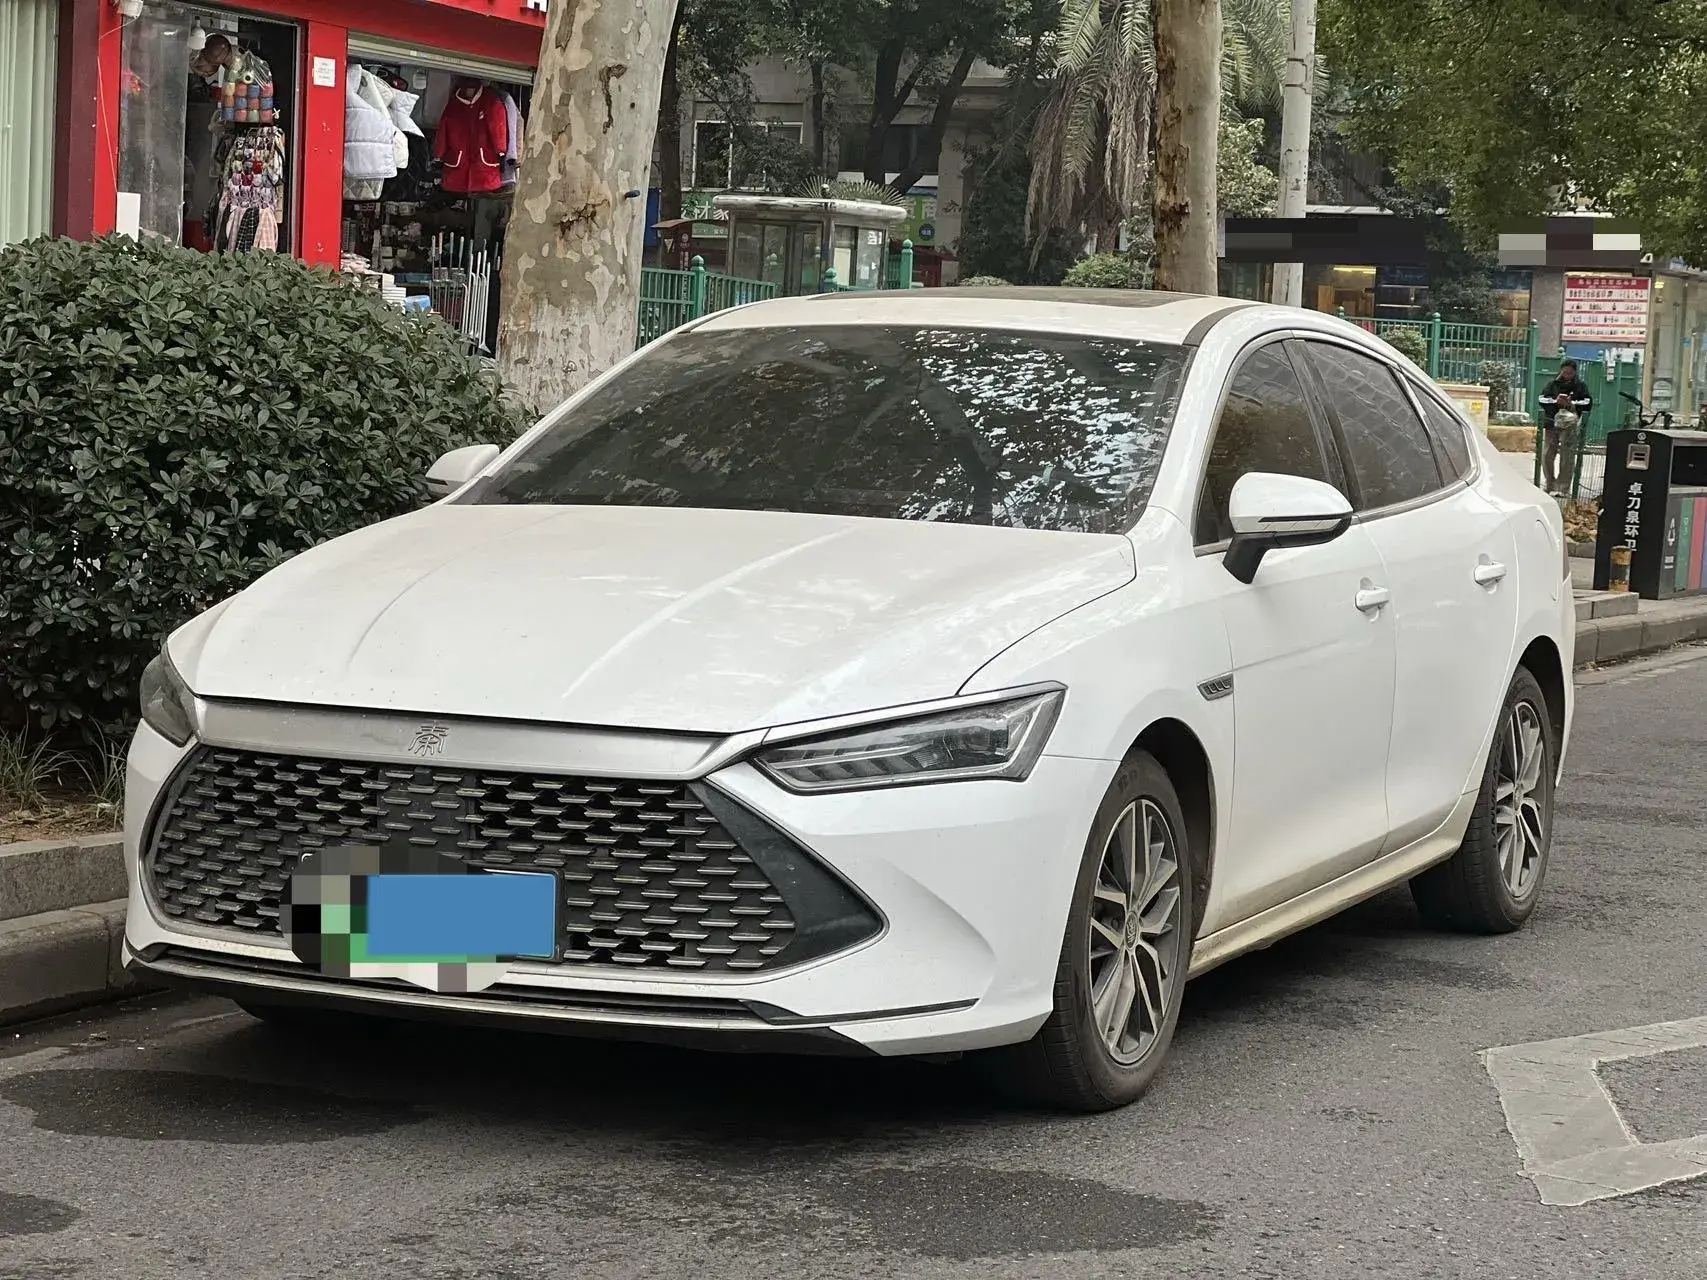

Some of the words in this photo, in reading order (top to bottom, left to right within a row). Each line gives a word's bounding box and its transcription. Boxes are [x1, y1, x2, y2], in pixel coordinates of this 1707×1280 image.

[1624, 482, 1643, 551] 卓刀泉环卫
[408, 720, 450, 757] 秦
